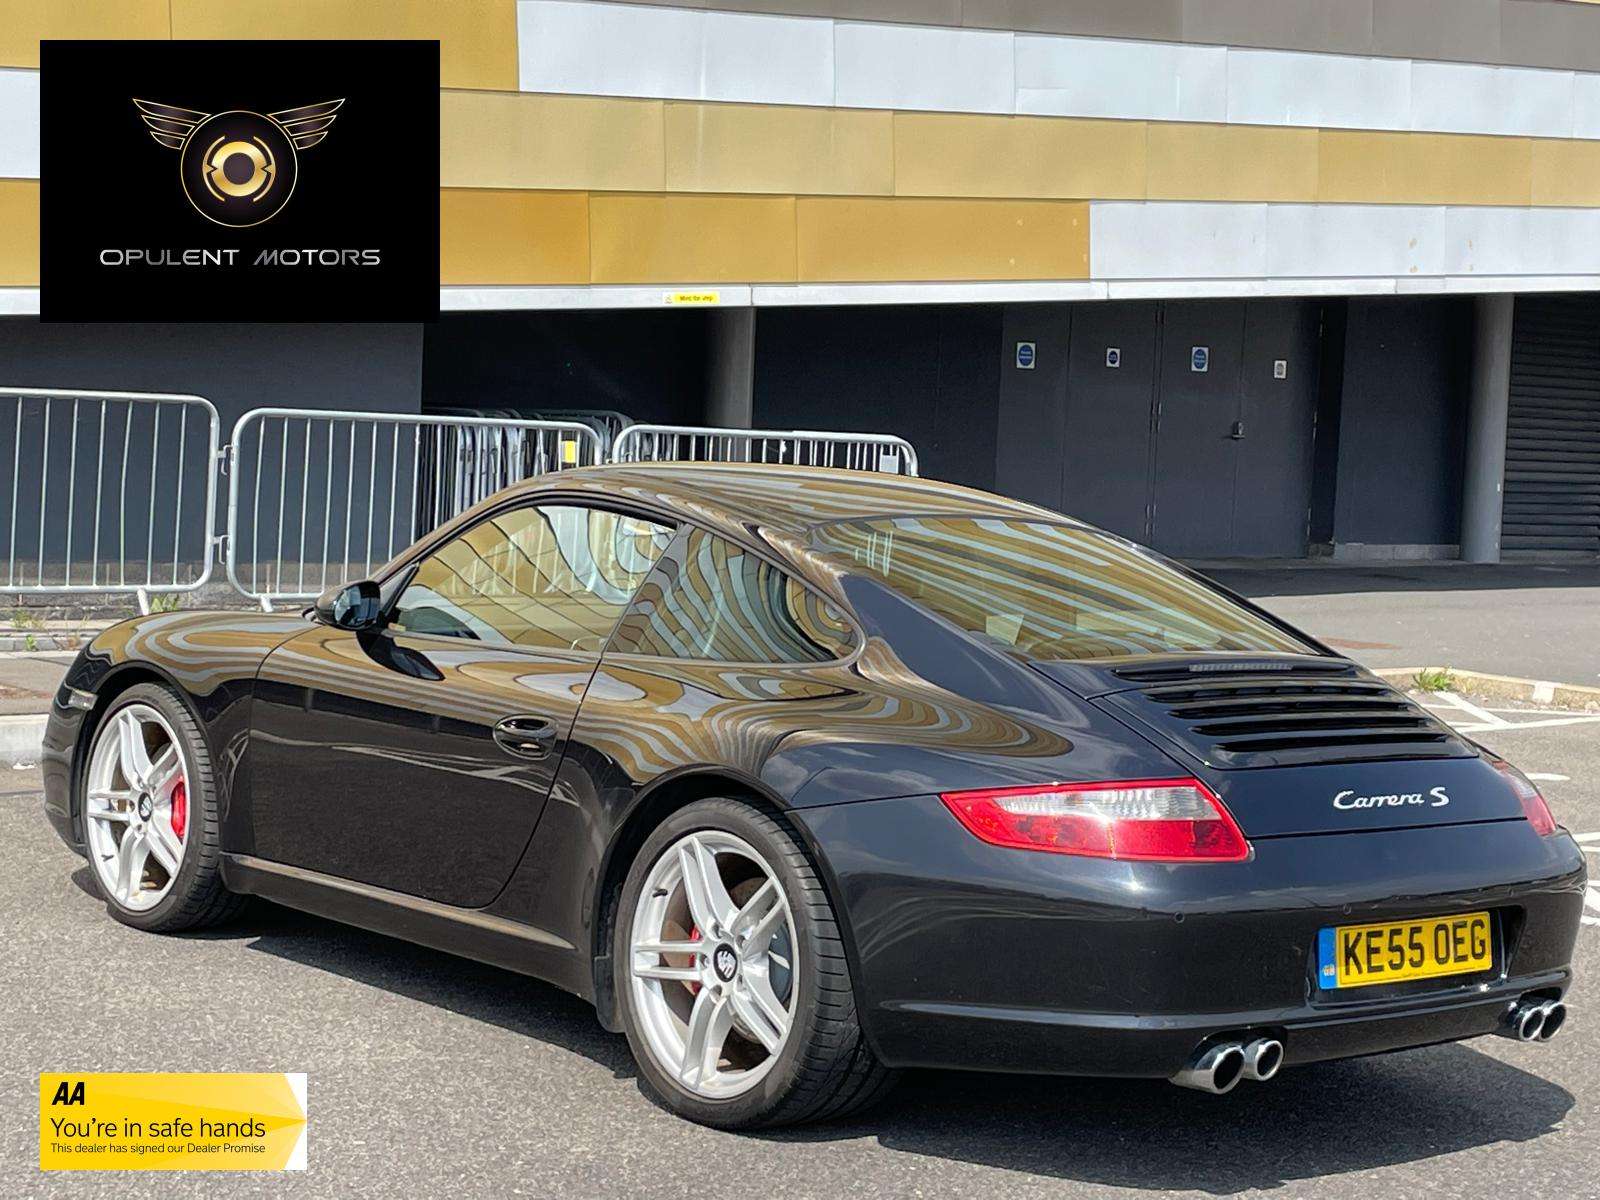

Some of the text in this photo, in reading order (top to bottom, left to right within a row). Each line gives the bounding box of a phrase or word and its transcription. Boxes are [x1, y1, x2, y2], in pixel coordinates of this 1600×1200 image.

[1333, 786, 1450, 810] Carrera S
[1343, 919, 1486, 976] KE55 OEG
